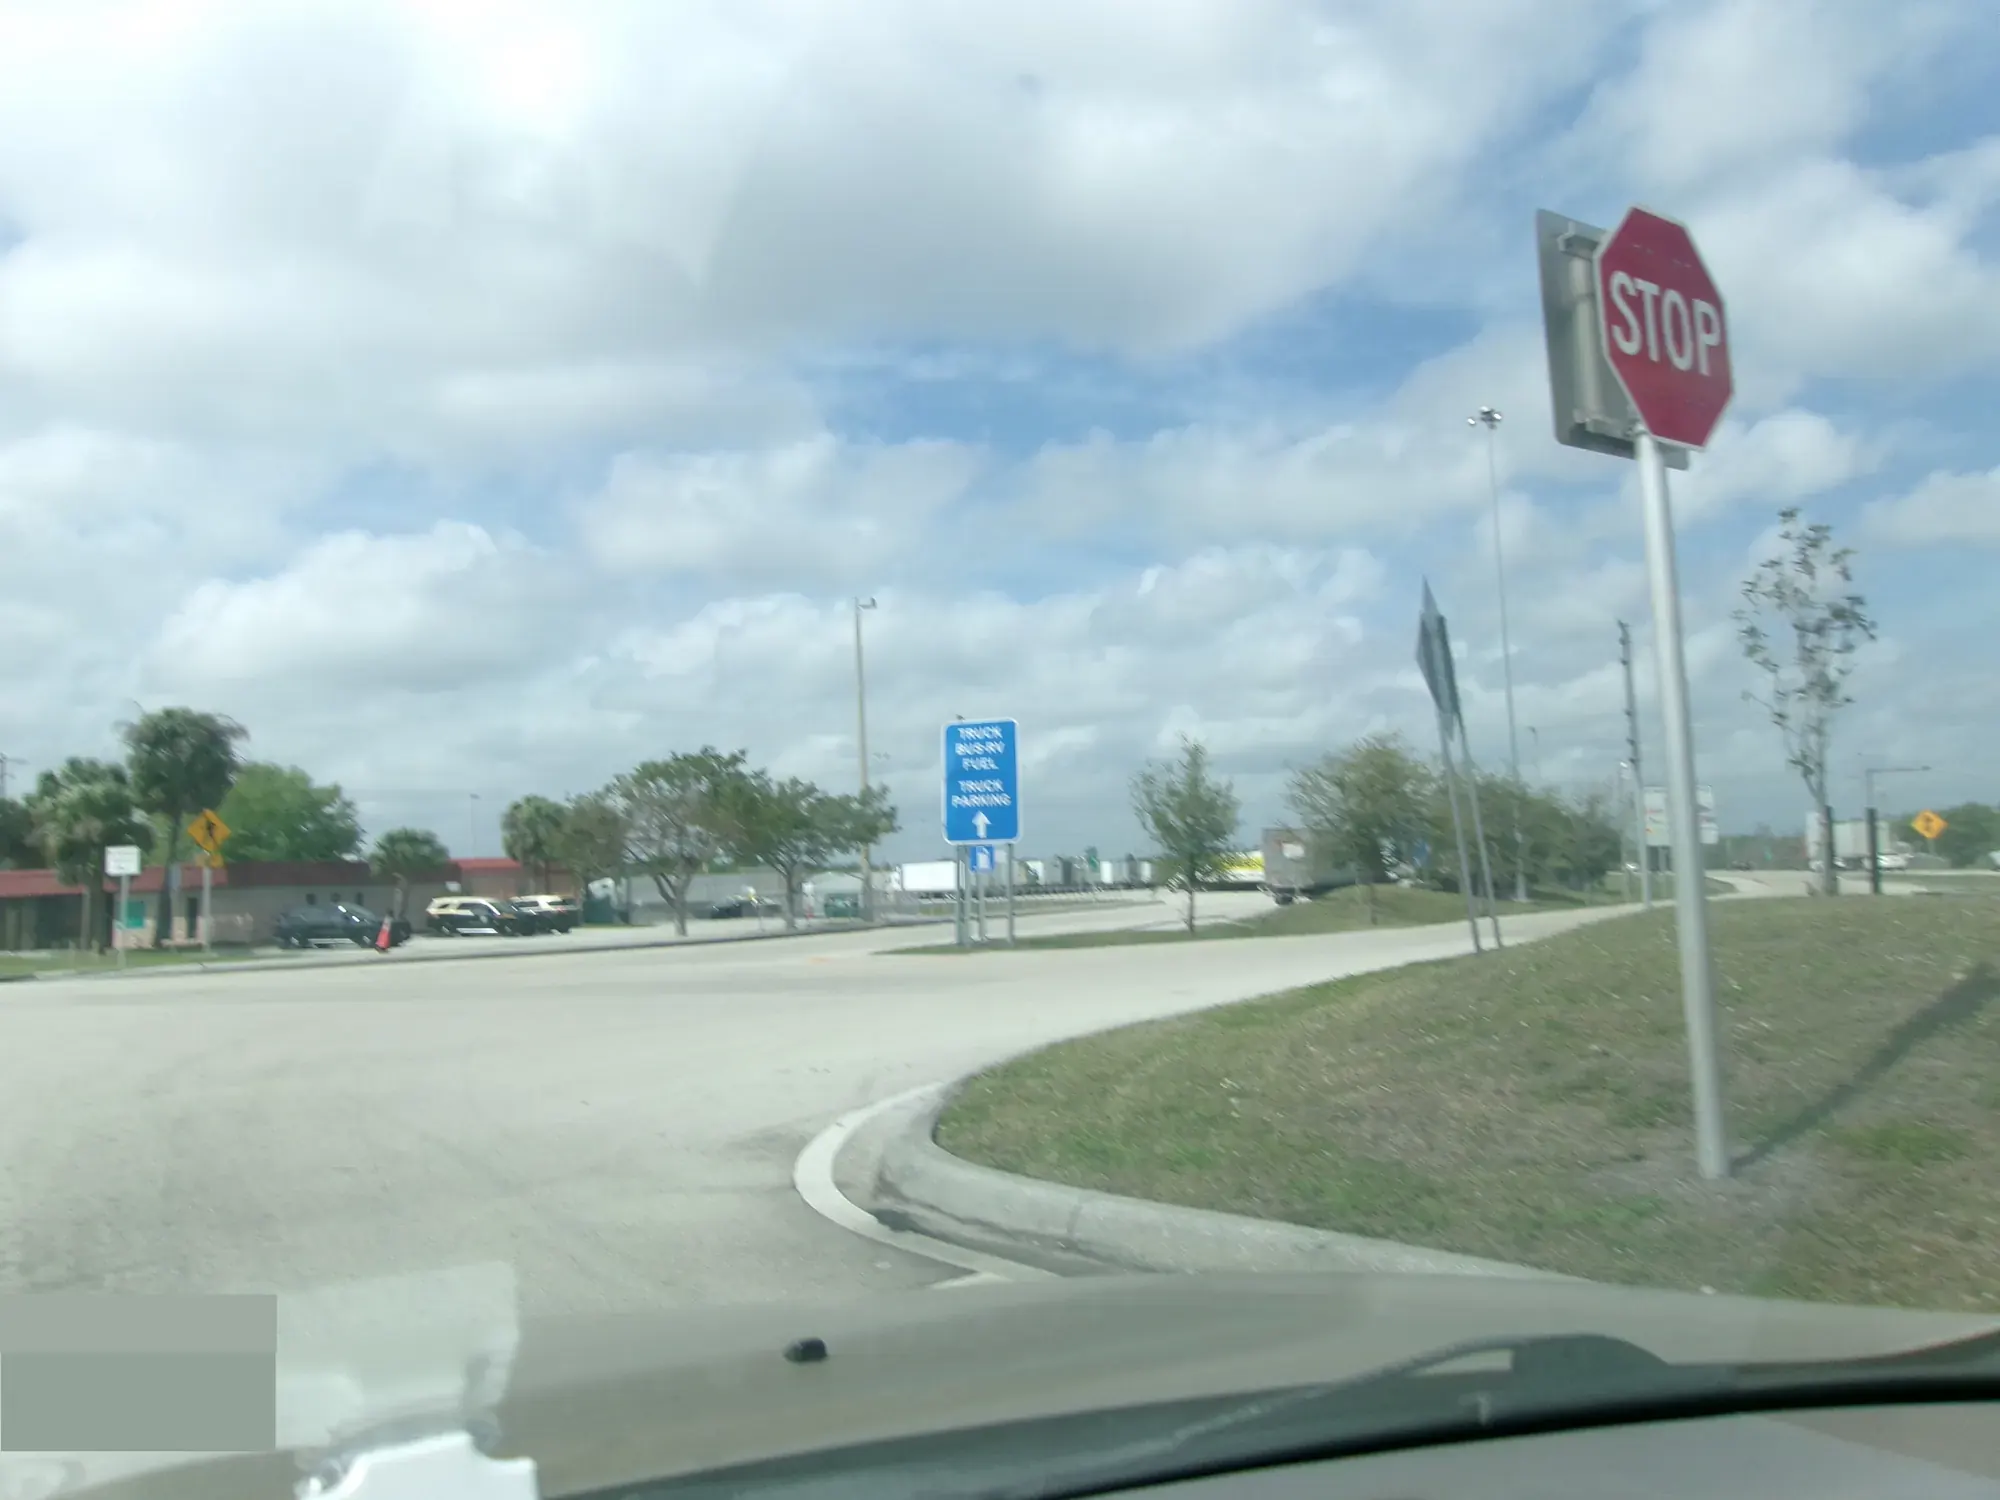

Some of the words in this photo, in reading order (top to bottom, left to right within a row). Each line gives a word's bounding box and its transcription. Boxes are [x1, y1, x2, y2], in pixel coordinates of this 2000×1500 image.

[1609, 270, 1720, 377] STOP
[957, 725, 1003, 740] TRUCK
[962, 756, 999, 771] FUEL
[957, 779, 1004, 793] TRUCK
[951, 793, 1011, 808] PARKING
